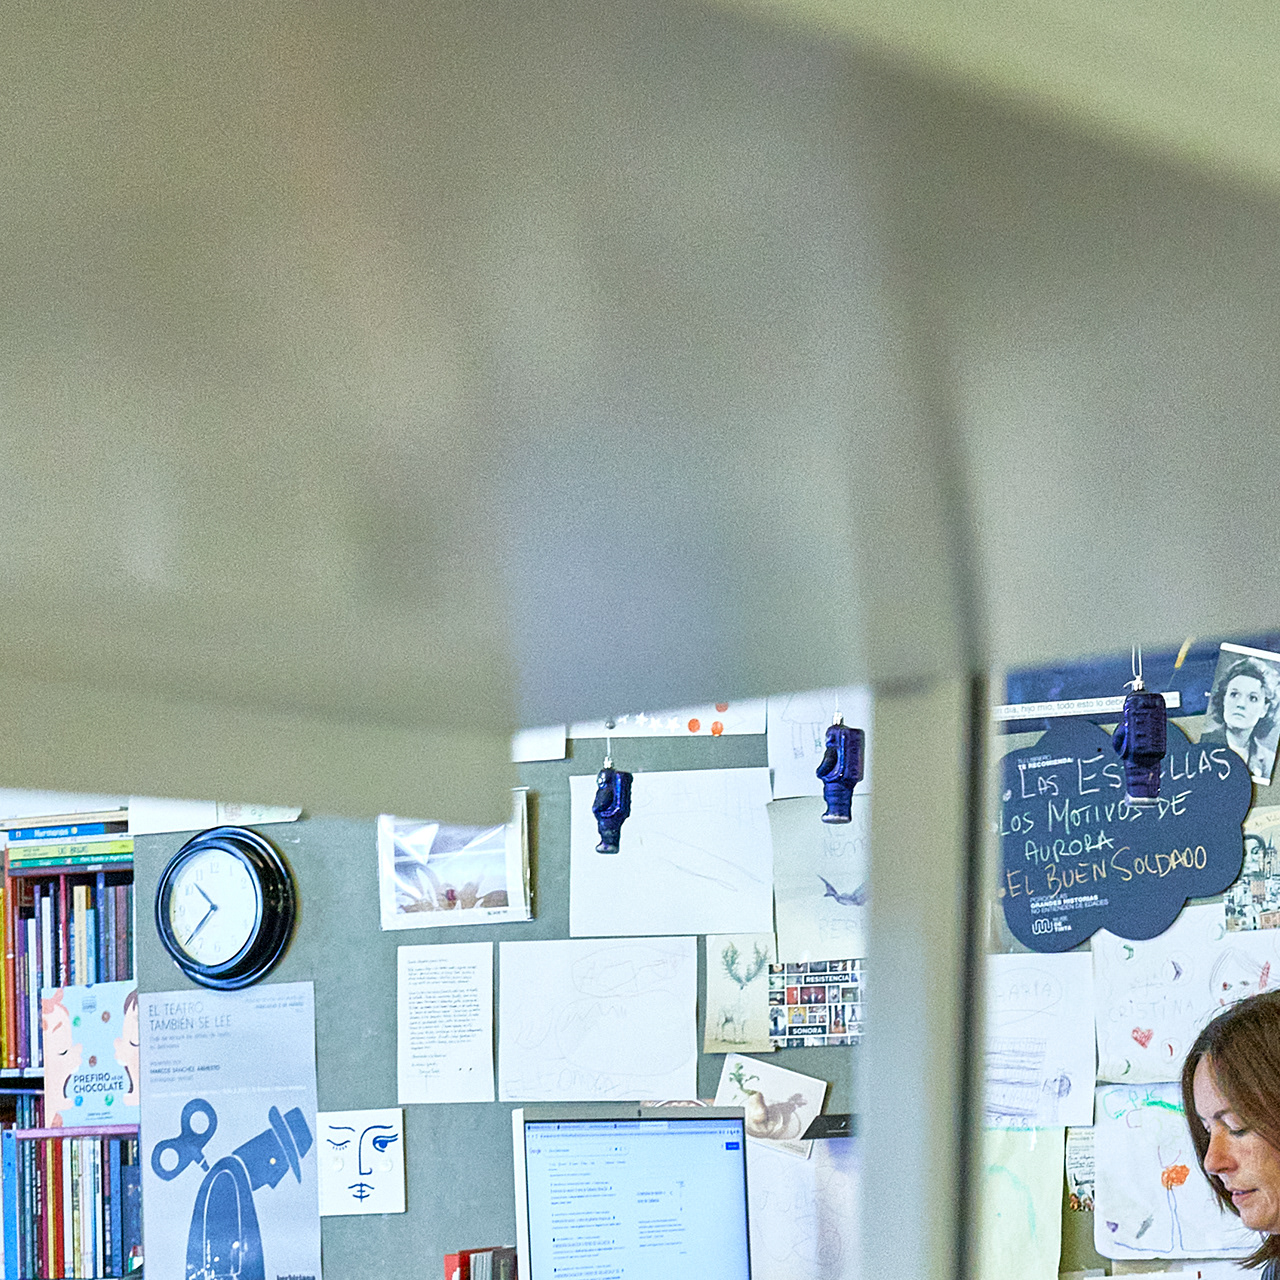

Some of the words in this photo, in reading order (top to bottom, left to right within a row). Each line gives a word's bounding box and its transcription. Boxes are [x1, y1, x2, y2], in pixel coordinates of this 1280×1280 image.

[1057, 702, 1075, 710] todo
[1077, 701, 1094, 709] esto
[1020, 765, 1060, 799] LAS
[1000, 810, 1035, 836] LOS
[1025, 829, 1114, 865] AURORA
[1006, 868, 1034, 898] EL
[1045, 861, 1107, 899] BUEN
[1110, 846, 1207, 882] SOLDADO
[1063, 894, 1098, 905] HISTORIAS
[806, 973, 849, 983] RESISTENCIA
[148, 1004, 160, 1018] EL
[164, 1001, 204, 1015] TEATRO
[198, 1016, 210, 1028] SE
[214, 1014, 232, 1027] LEE
[792, 1027, 823, 1035] SONORA
[74, 1072, 111, 1083] PREFIRO
[73, 1081, 124, 1094] CHOCOLATE
